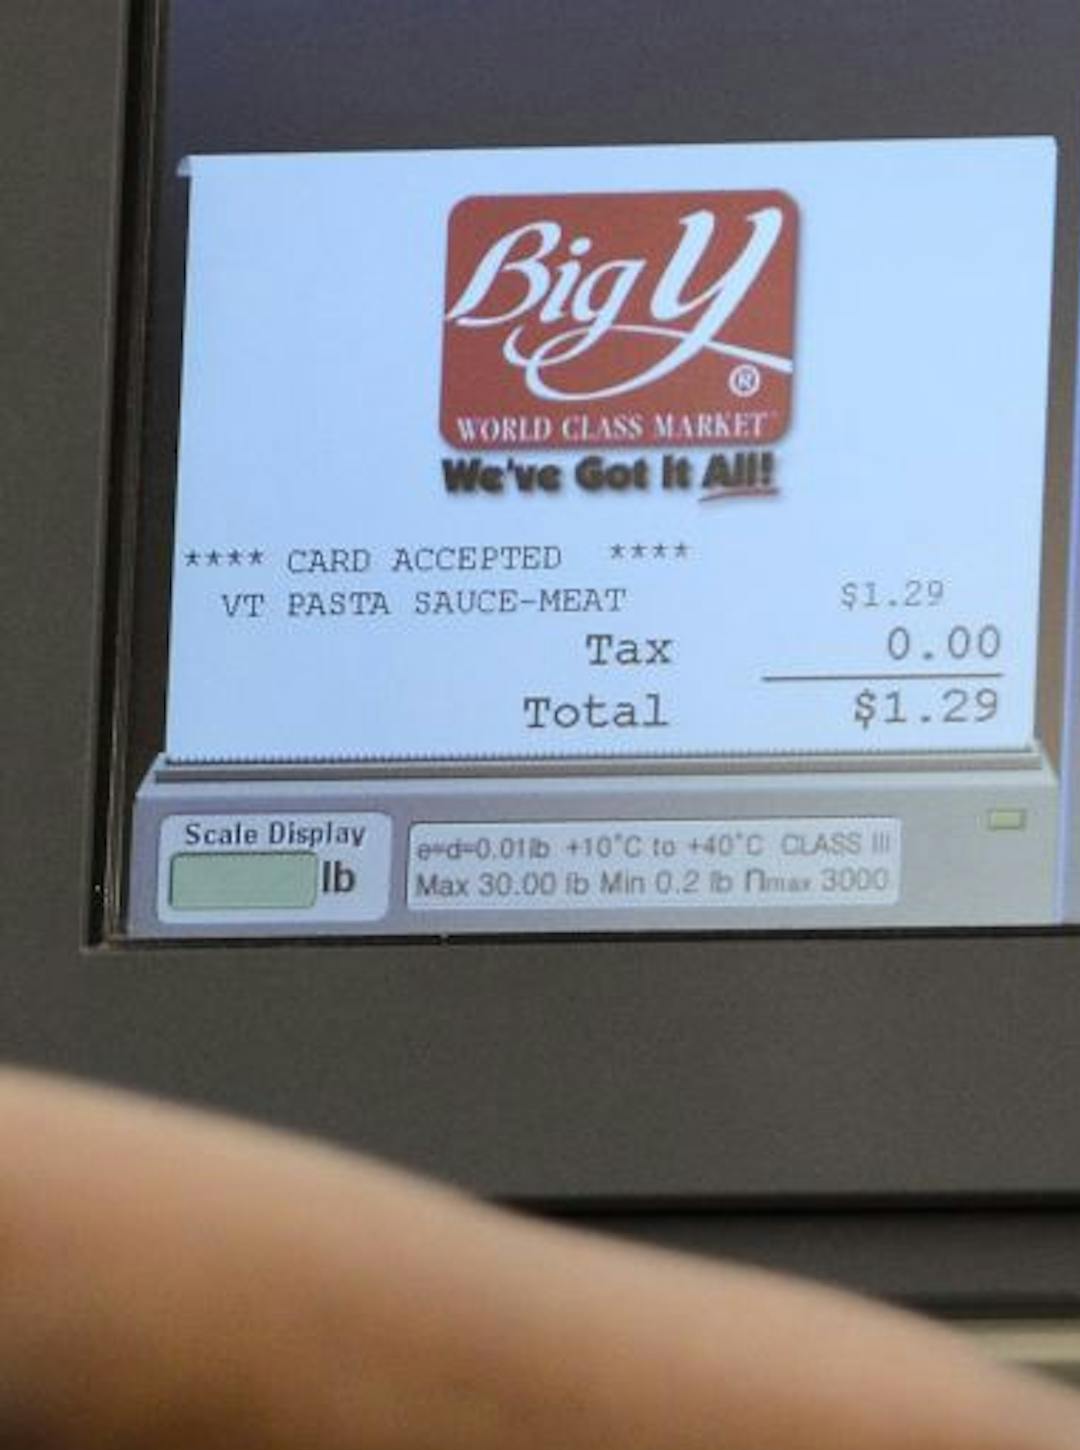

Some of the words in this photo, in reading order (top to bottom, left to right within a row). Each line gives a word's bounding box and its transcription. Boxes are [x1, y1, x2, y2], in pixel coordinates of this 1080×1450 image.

[446, 220, 648, 369] Big
[457, 416, 552, 442] WORLD
[561, 414, 643, 440] CLASS
[653, 411, 767, 439] MARKET
[441, 457, 562, 493] We've
[574, 455, 649, 491] Got
[702, 451, 776, 489] All!
[287, 549, 371, 574] CARD
[391, 546, 562, 571] ACCEPTED
[221, 593, 265, 618] VT
[287, 591, 392, 616] PASTA
[414, 588, 627, 614] SAUCE-MEAT
[841, 579, 945, 611] $1.29
[586, 633, 675, 667] Tax
[887, 624, 1002, 661] 0.00
[523, 694, 670, 730] Total
[853, 687, 999, 730] $1.29
[184, 822, 258, 846] Scale
[269, 820, 366, 848] Display
[652, 836, 676, 857] to
[781, 831, 862, 856] CLASS
[322, 860, 356, 894] lb
[416, 873, 470, 897] Max
[477, 871, 557, 896] 30.00
[600, 870, 646, 895] Min
[655, 869, 700, 895] 0.2
[821, 867, 889, 892] 3000
